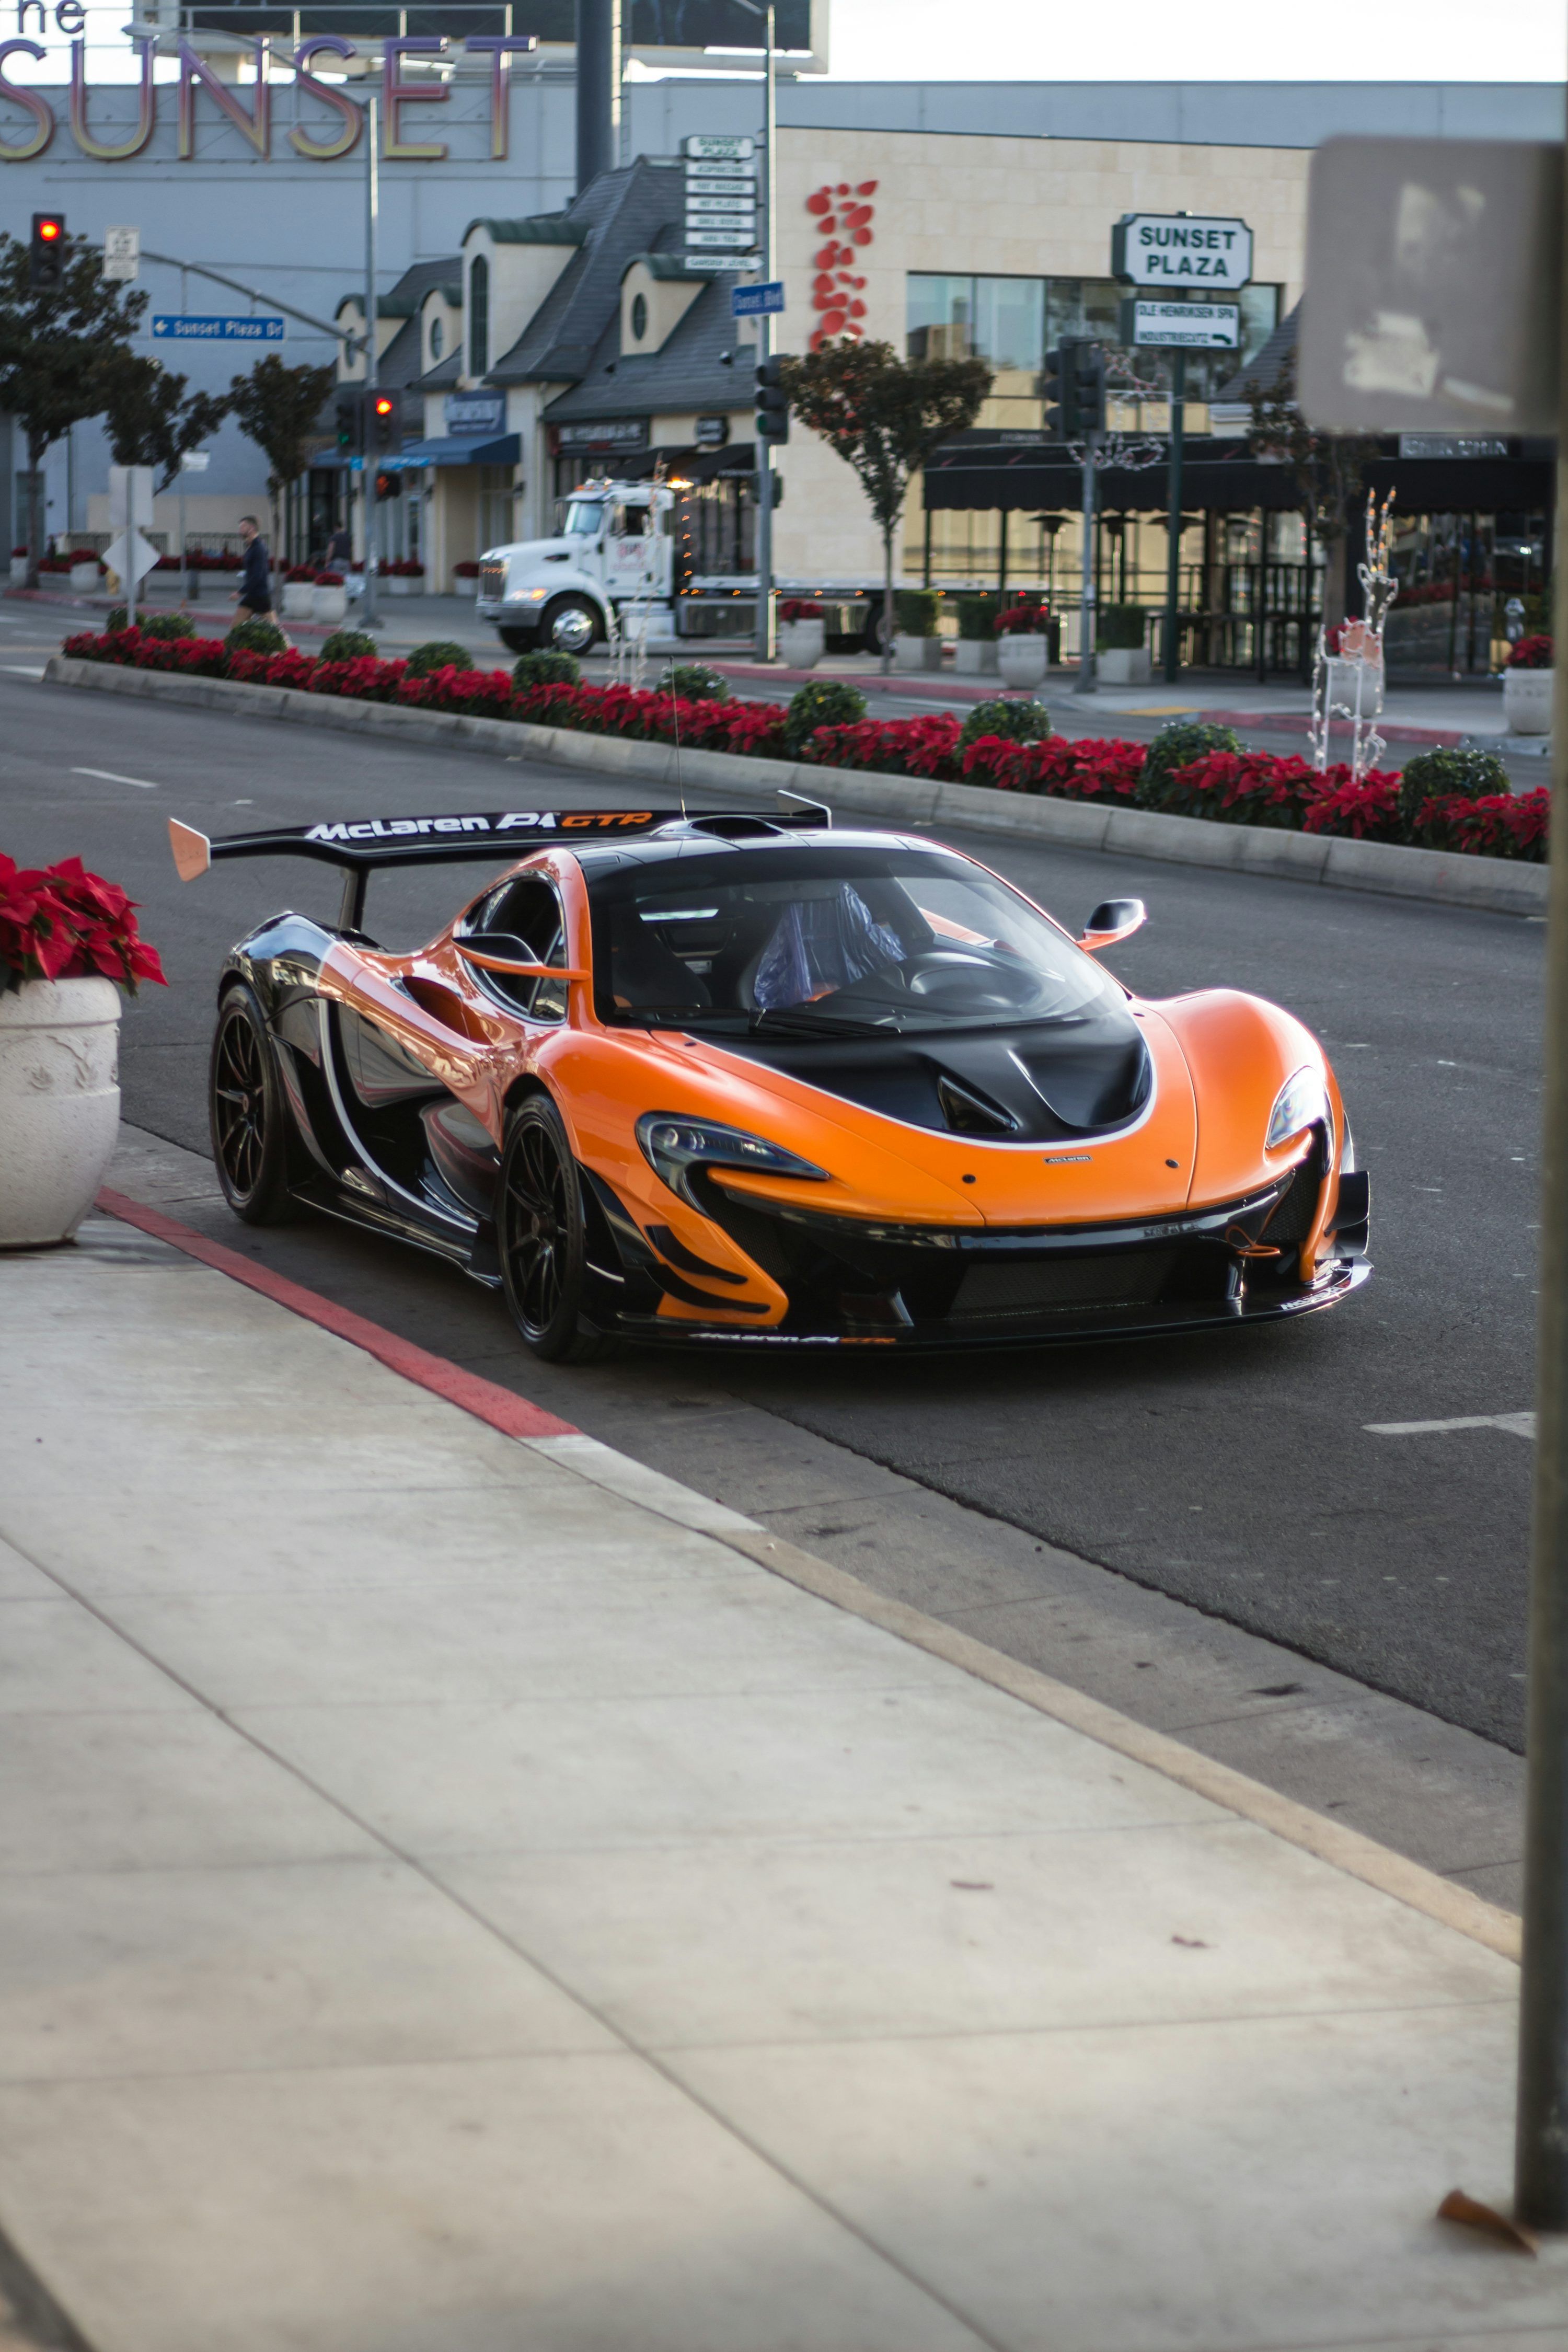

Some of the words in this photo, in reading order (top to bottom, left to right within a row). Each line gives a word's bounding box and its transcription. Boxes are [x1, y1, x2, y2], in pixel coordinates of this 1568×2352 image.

[0, 36, 538, 161] SUNSET
[699, 137, 742, 146] SUNSET
[702, 147, 739, 156] PLAZA
[1139, 226, 1237, 250] SUNSET
[1147, 253, 1229, 277] PLAZA
[174, 320, 221, 336] Sunset
[225, 320, 262, 337] Plaza
[267, 321, 283, 338] Dr
[304, 817, 490, 840] McLaren
[495, 812, 556, 829] P1
[561, 812, 653, 827] GTR
[688, 1333, 799, 1342] McLaren
